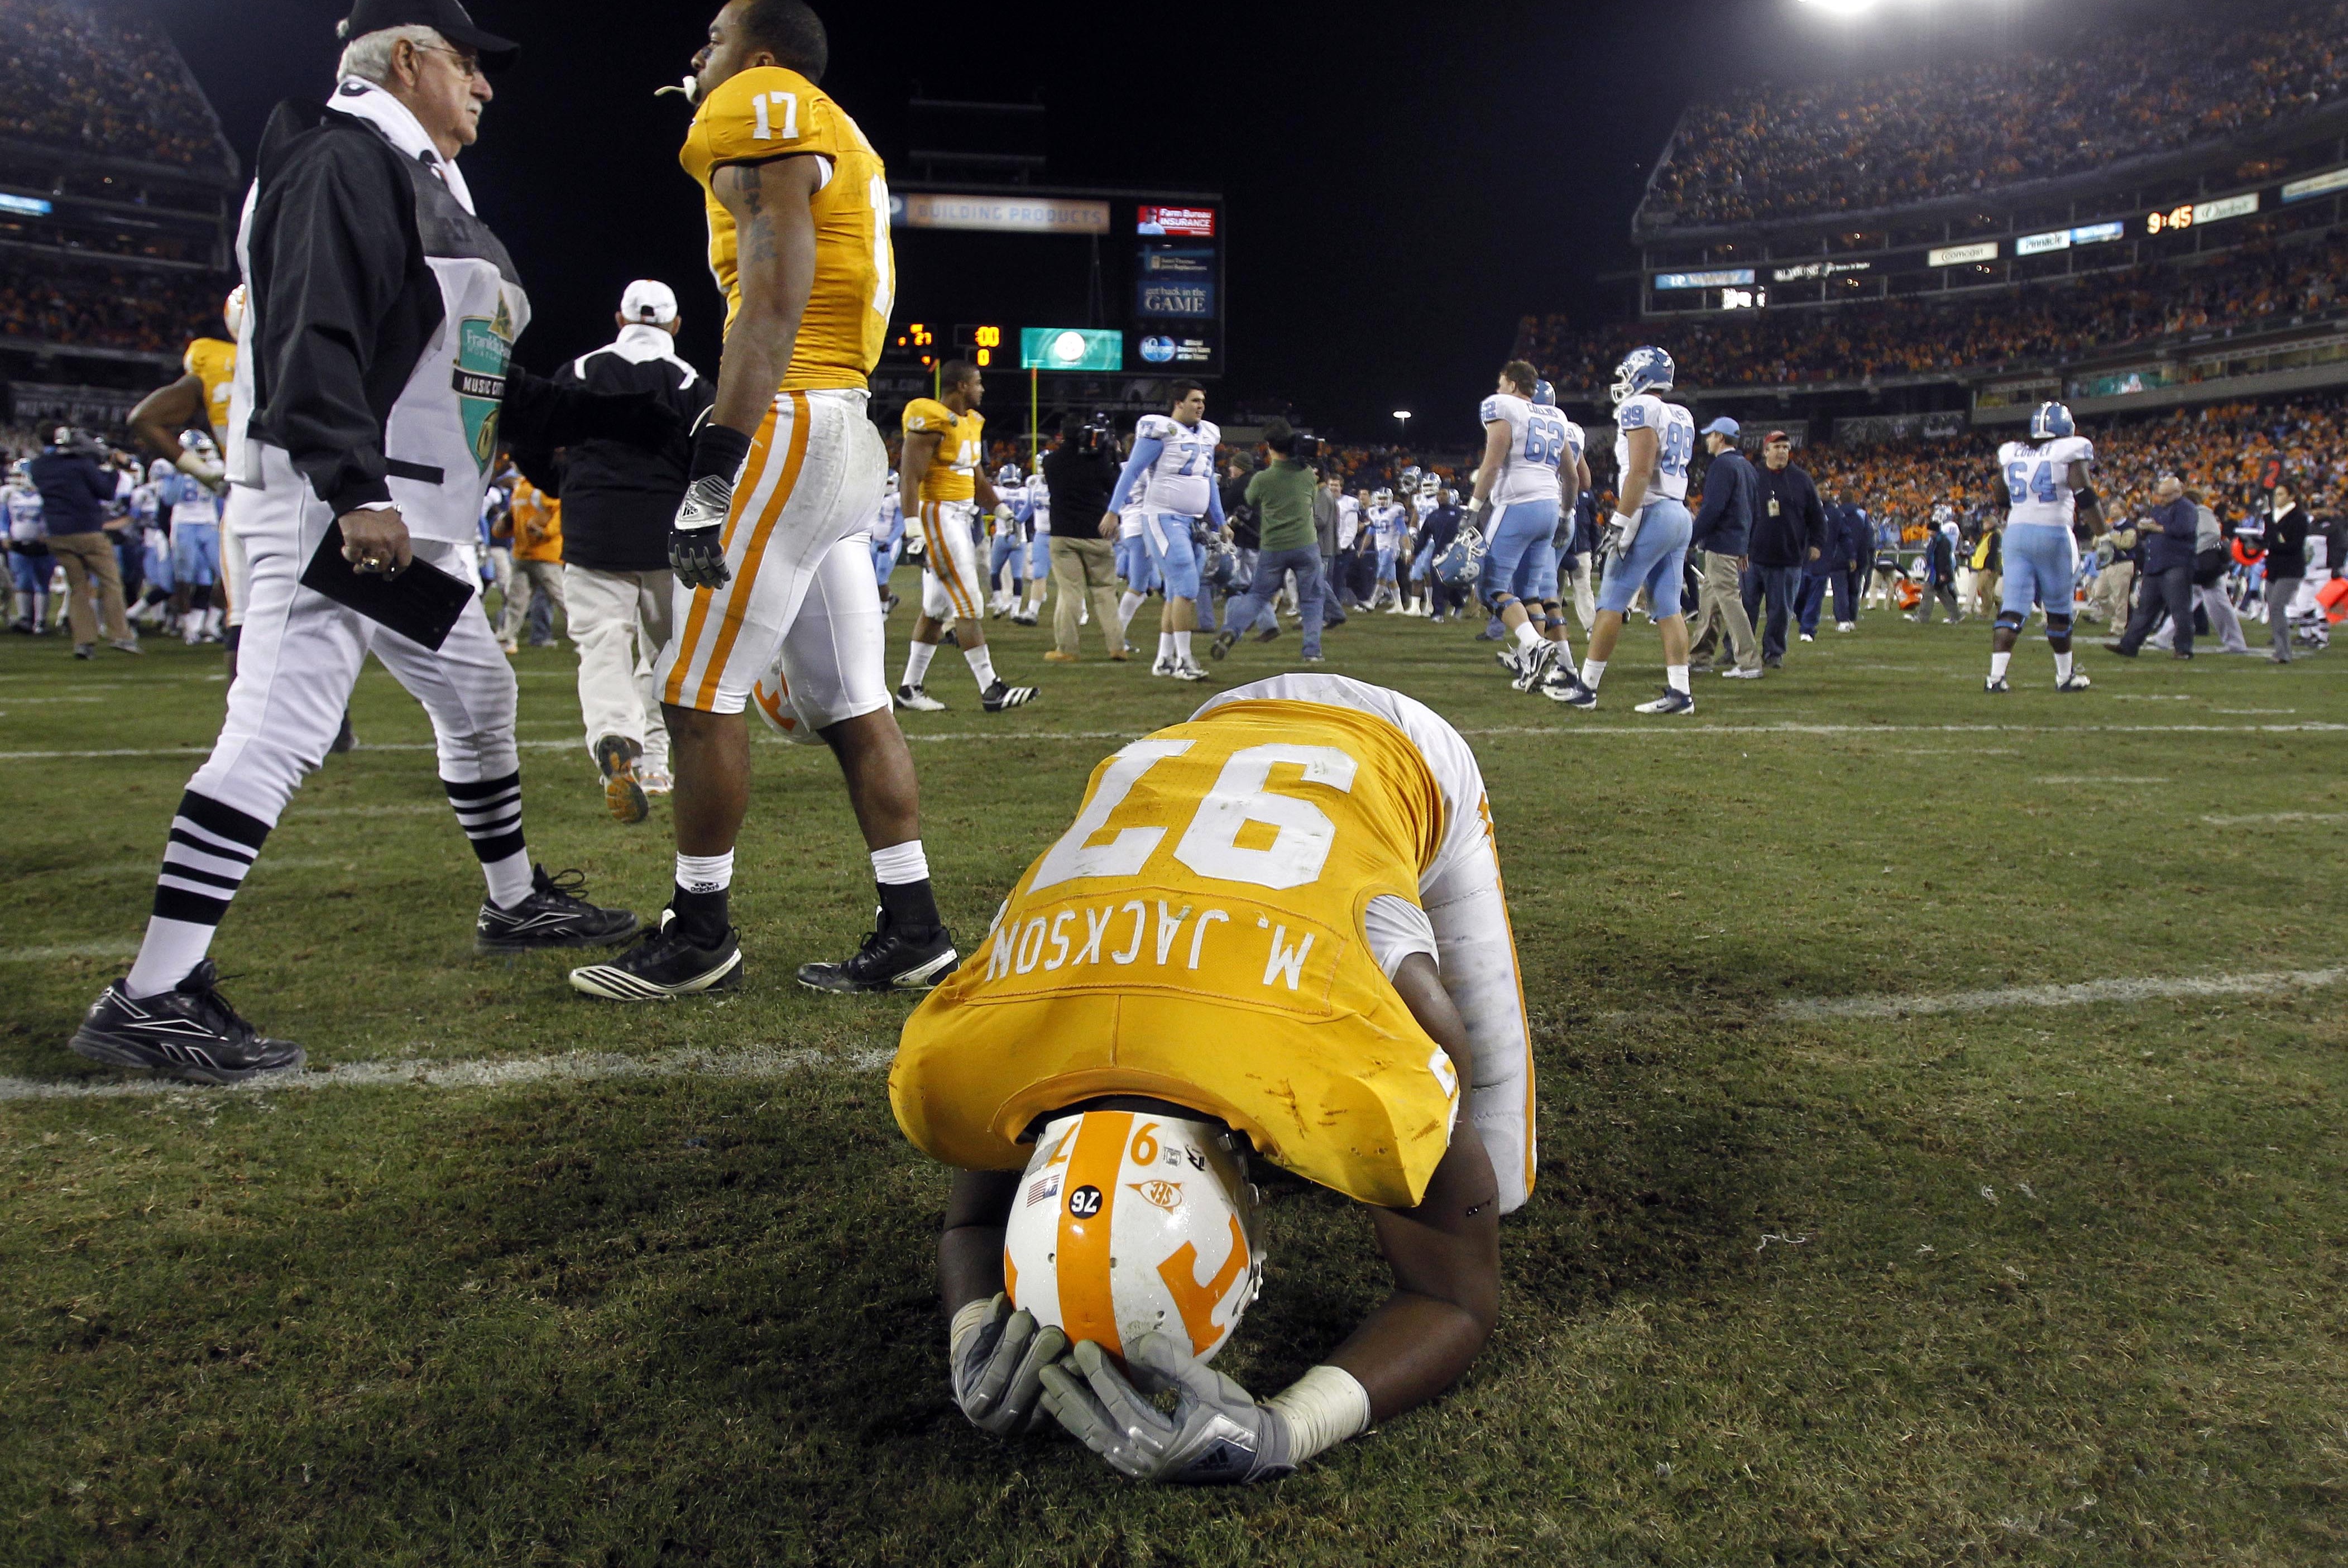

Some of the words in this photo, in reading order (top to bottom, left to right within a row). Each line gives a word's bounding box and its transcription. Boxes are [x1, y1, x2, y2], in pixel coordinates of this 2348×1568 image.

[753, 92, 798, 140] 17
[917, 204, 1003, 220] BUILDING
[1008, 207, 1103, 224] PRODUCTS
[1159, 208, 1182, 217] Farm
[1182, 209, 1211, 218] Bureau
[1159, 217, 1211, 227] INSURANCE
[2147, 204, 2193, 234] 9:45
[2025, 234, 2063, 251] Pinnacle
[1145, 295, 1205, 312] GAME
[977, 348, 990, 367] 0
[462, 376, 491, 395] MUSIC
[1621, 404, 1645, 428] 89
[1524, 416, 1564, 468] 62
[1661, 421, 1694, 478] 89
[2008, 461, 2058, 504] 64
[2263, 460, 2280, 490] 2
[1027, 739, 1359, 894] 97
[690, 883, 720, 893] adidas
[985, 898, 1230, 984] JACKSON
[1262, 914, 1316, 991] M.
[1071, 1191, 1100, 1213] 76
[1149, 1181, 1173, 1206] SEC
